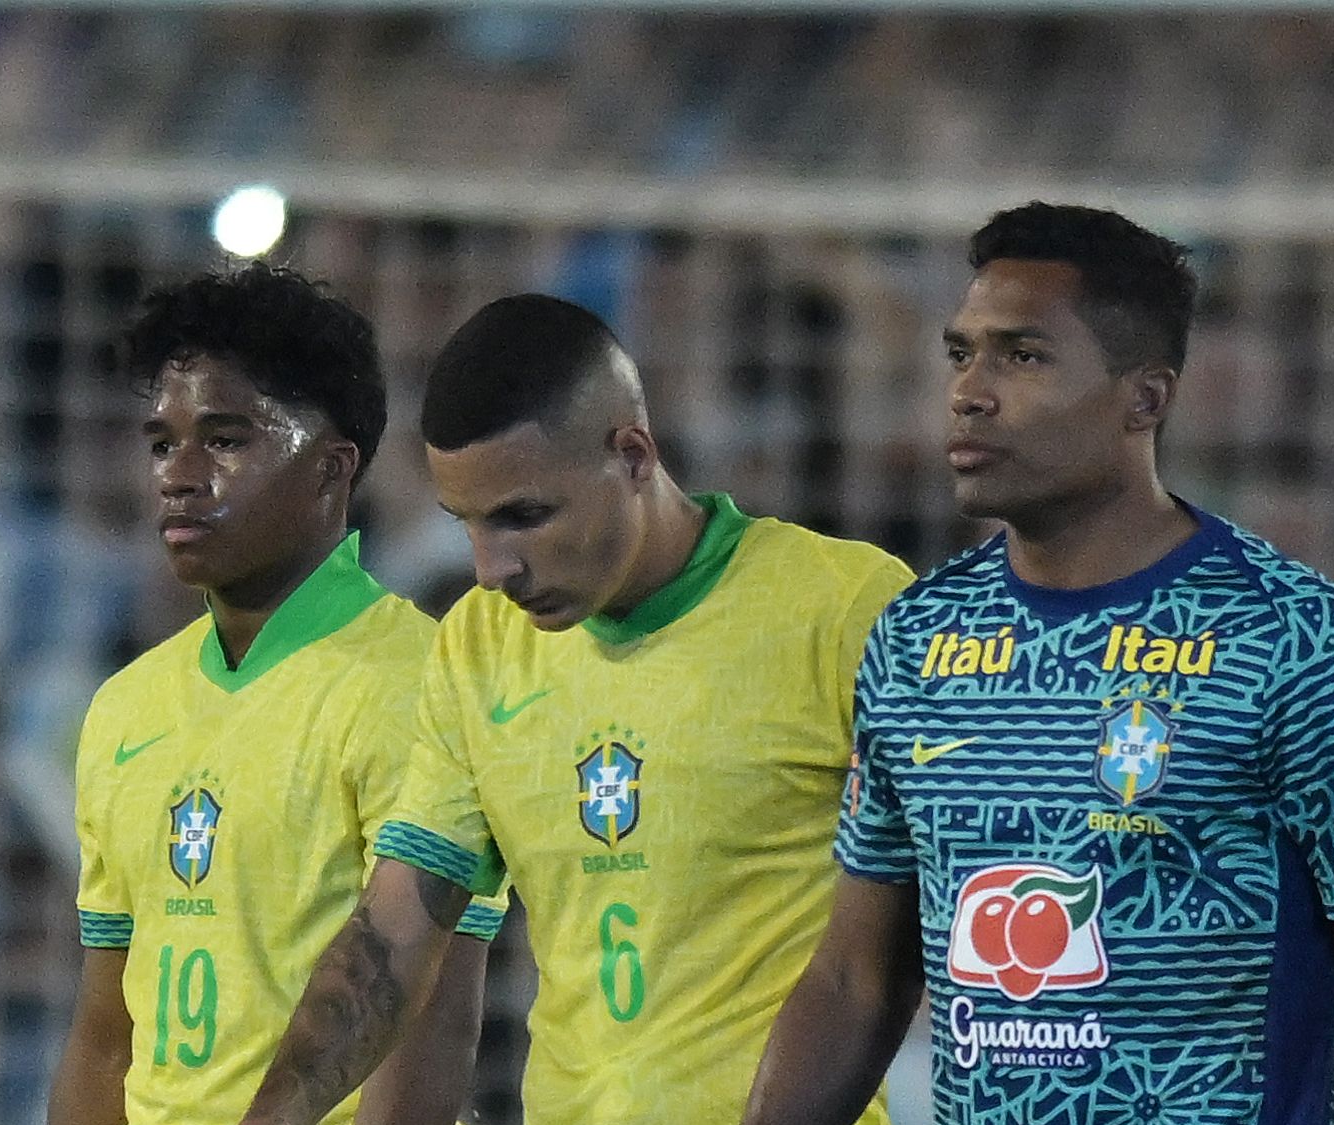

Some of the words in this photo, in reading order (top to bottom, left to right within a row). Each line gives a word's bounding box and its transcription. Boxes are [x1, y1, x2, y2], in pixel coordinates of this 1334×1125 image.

[921, 627, 1014, 678] Itaú
[1102, 625, 1216, 675] Itaú
[1119, 743, 1148, 756] CBF
[595, 784, 621, 798] CBF
[1088, 812, 1170, 834] BRASIL
[185, 828, 205, 843] CBF
[581, 851, 650, 874] BRASIL
[166, 898, 217, 916] BRASIL
[599, 902, 645, 1022] 6
[153, 945, 218, 1068] 19
[950, 996, 1111, 1069] Guaraná
[992, 1053, 1085, 1066] ANTARCTICA
